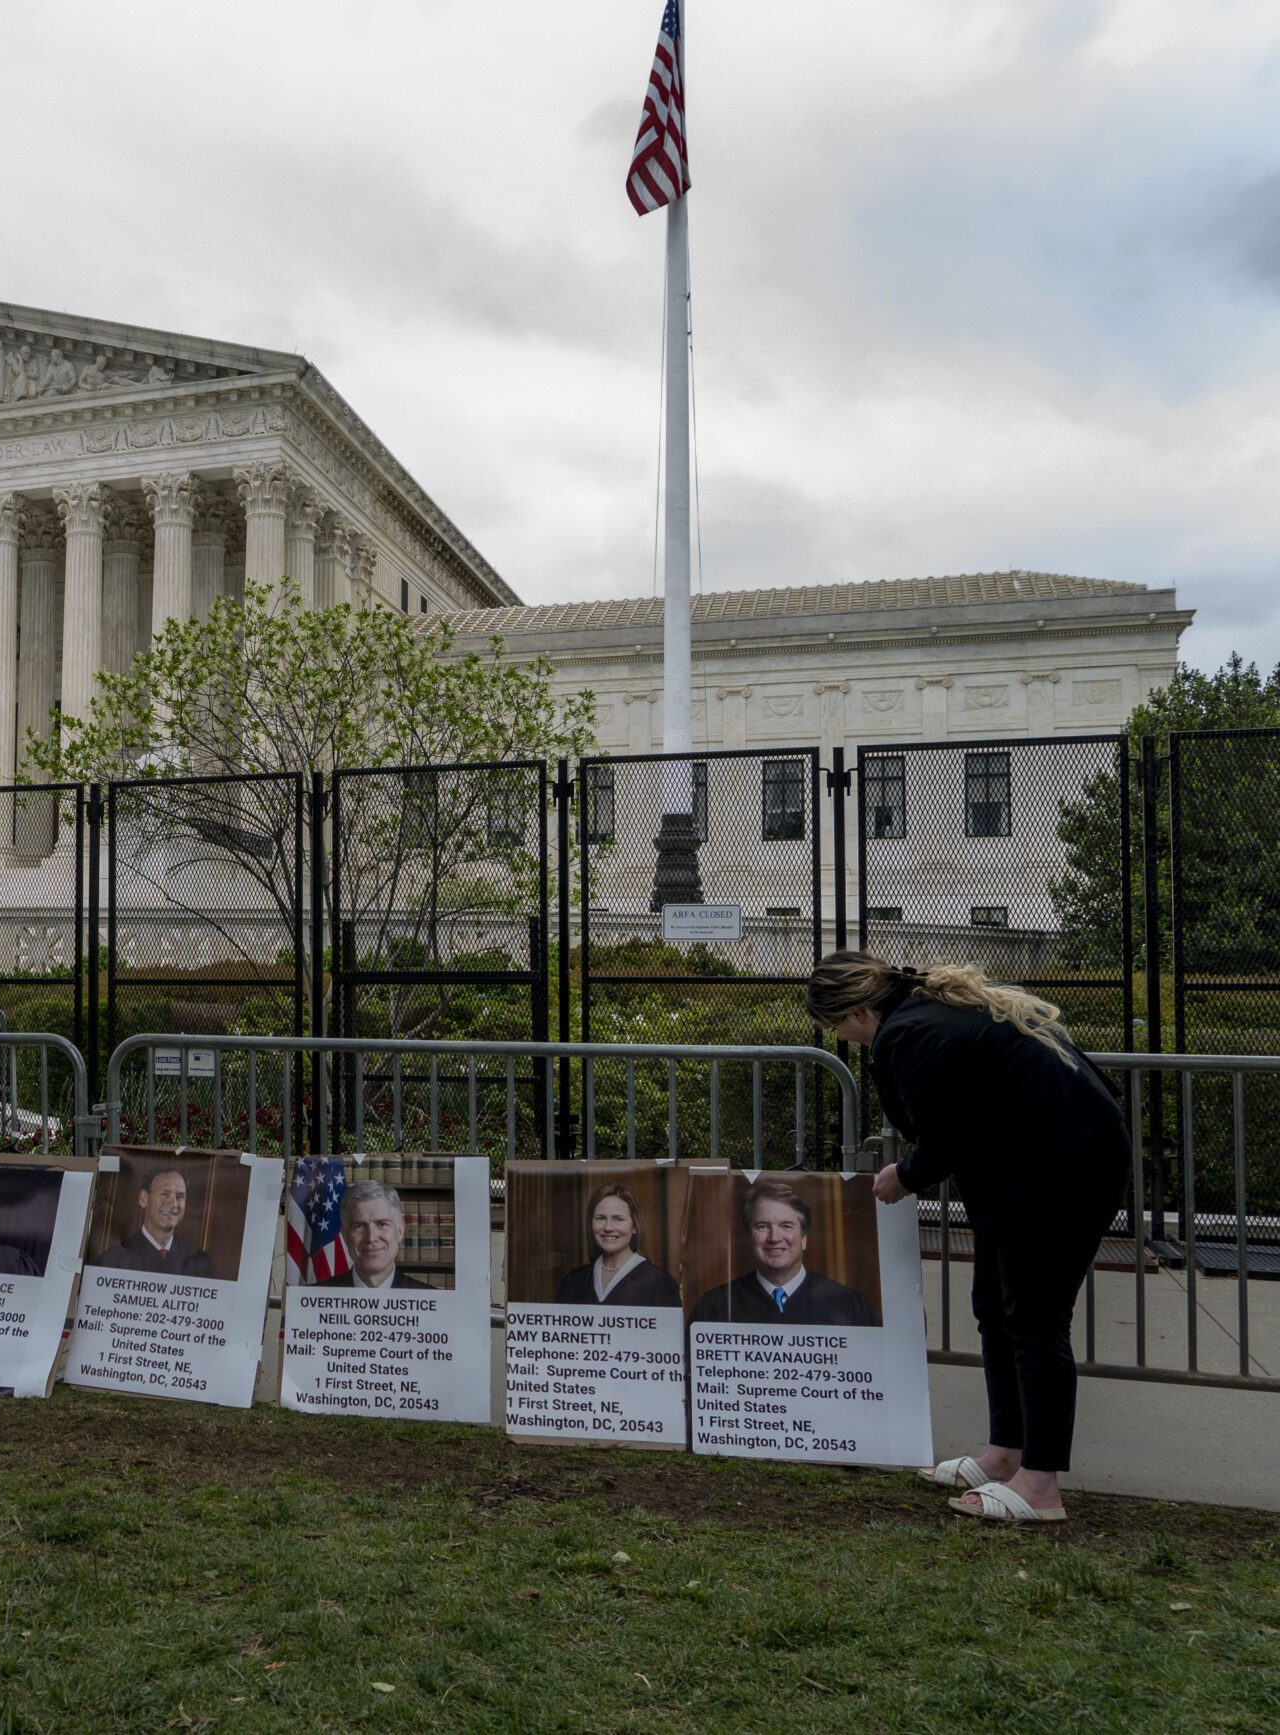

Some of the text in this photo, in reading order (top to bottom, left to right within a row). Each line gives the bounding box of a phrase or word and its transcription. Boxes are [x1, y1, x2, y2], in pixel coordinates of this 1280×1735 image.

[31, 438, 67, 456] LAW
[672, 910, 733, 919] AREA CLOSED
[96, 1276, 218, 1300] OVERTHROW JUSTICE
[112, 1293, 200, 1313] SAMUEL ALITO!
[300, 1296, 437, 1312] OVERTHROW JUSTICE
[84, 1304, 224, 1331] Telephone: 202-479-3000
[319, 1313, 419, 1327] NEIIL GORSUCH!
[506, 1313, 657, 1330] OVERTHROW JUSTICE
[11, 1326, 29, 1338] the
[77, 1318, 226, 1347] Mail: Supreme Court of the
[291, 1328, 448, 1344] Telephone: 202-479-3000
[506, 1330, 611, 1345] AMY BARNETT!
[696, 1332, 848, 1348] OVERTHROW JUSTICE
[112, 1338, 184, 1357] United States
[286, 1344, 453, 1361] Mail: Supreme Court of the
[506, 1346, 681, 1365] Telephone: 202-479-3000
[99, 1352, 192, 1376] 1 First Street, NE,
[696, 1349, 838, 1365] BRETT KAVANAUGH!
[80, 1364, 207, 1391] Washington, DC, 20543
[327, 1361, 409, 1376] United States
[506, 1362, 539, 1376] Mail:
[546, 1364, 607, 1380] Supreme
[610, 1367, 648, 1381] Court
[651, 1368, 666, 1381] of
[696, 1365, 872, 1384] Telephone: 202-479-3000
[315, 1377, 421, 1395] 1 First Street, NE,
[506, 1380, 596, 1396] United States
[696, 1382, 884, 1401] Mail: Supreme Court of the
[296, 1392, 439, 1410] Washington, DC, 20543
[507, 1396, 623, 1416] 1 First Street, NE,
[697, 1398, 787, 1414] United States
[506, 1413, 663, 1433] Washington, DC, 20543
[698, 1416, 816, 1435] 1 First Street, NE,
[697, 1432, 856, 1452] Washington, DC, 20543
